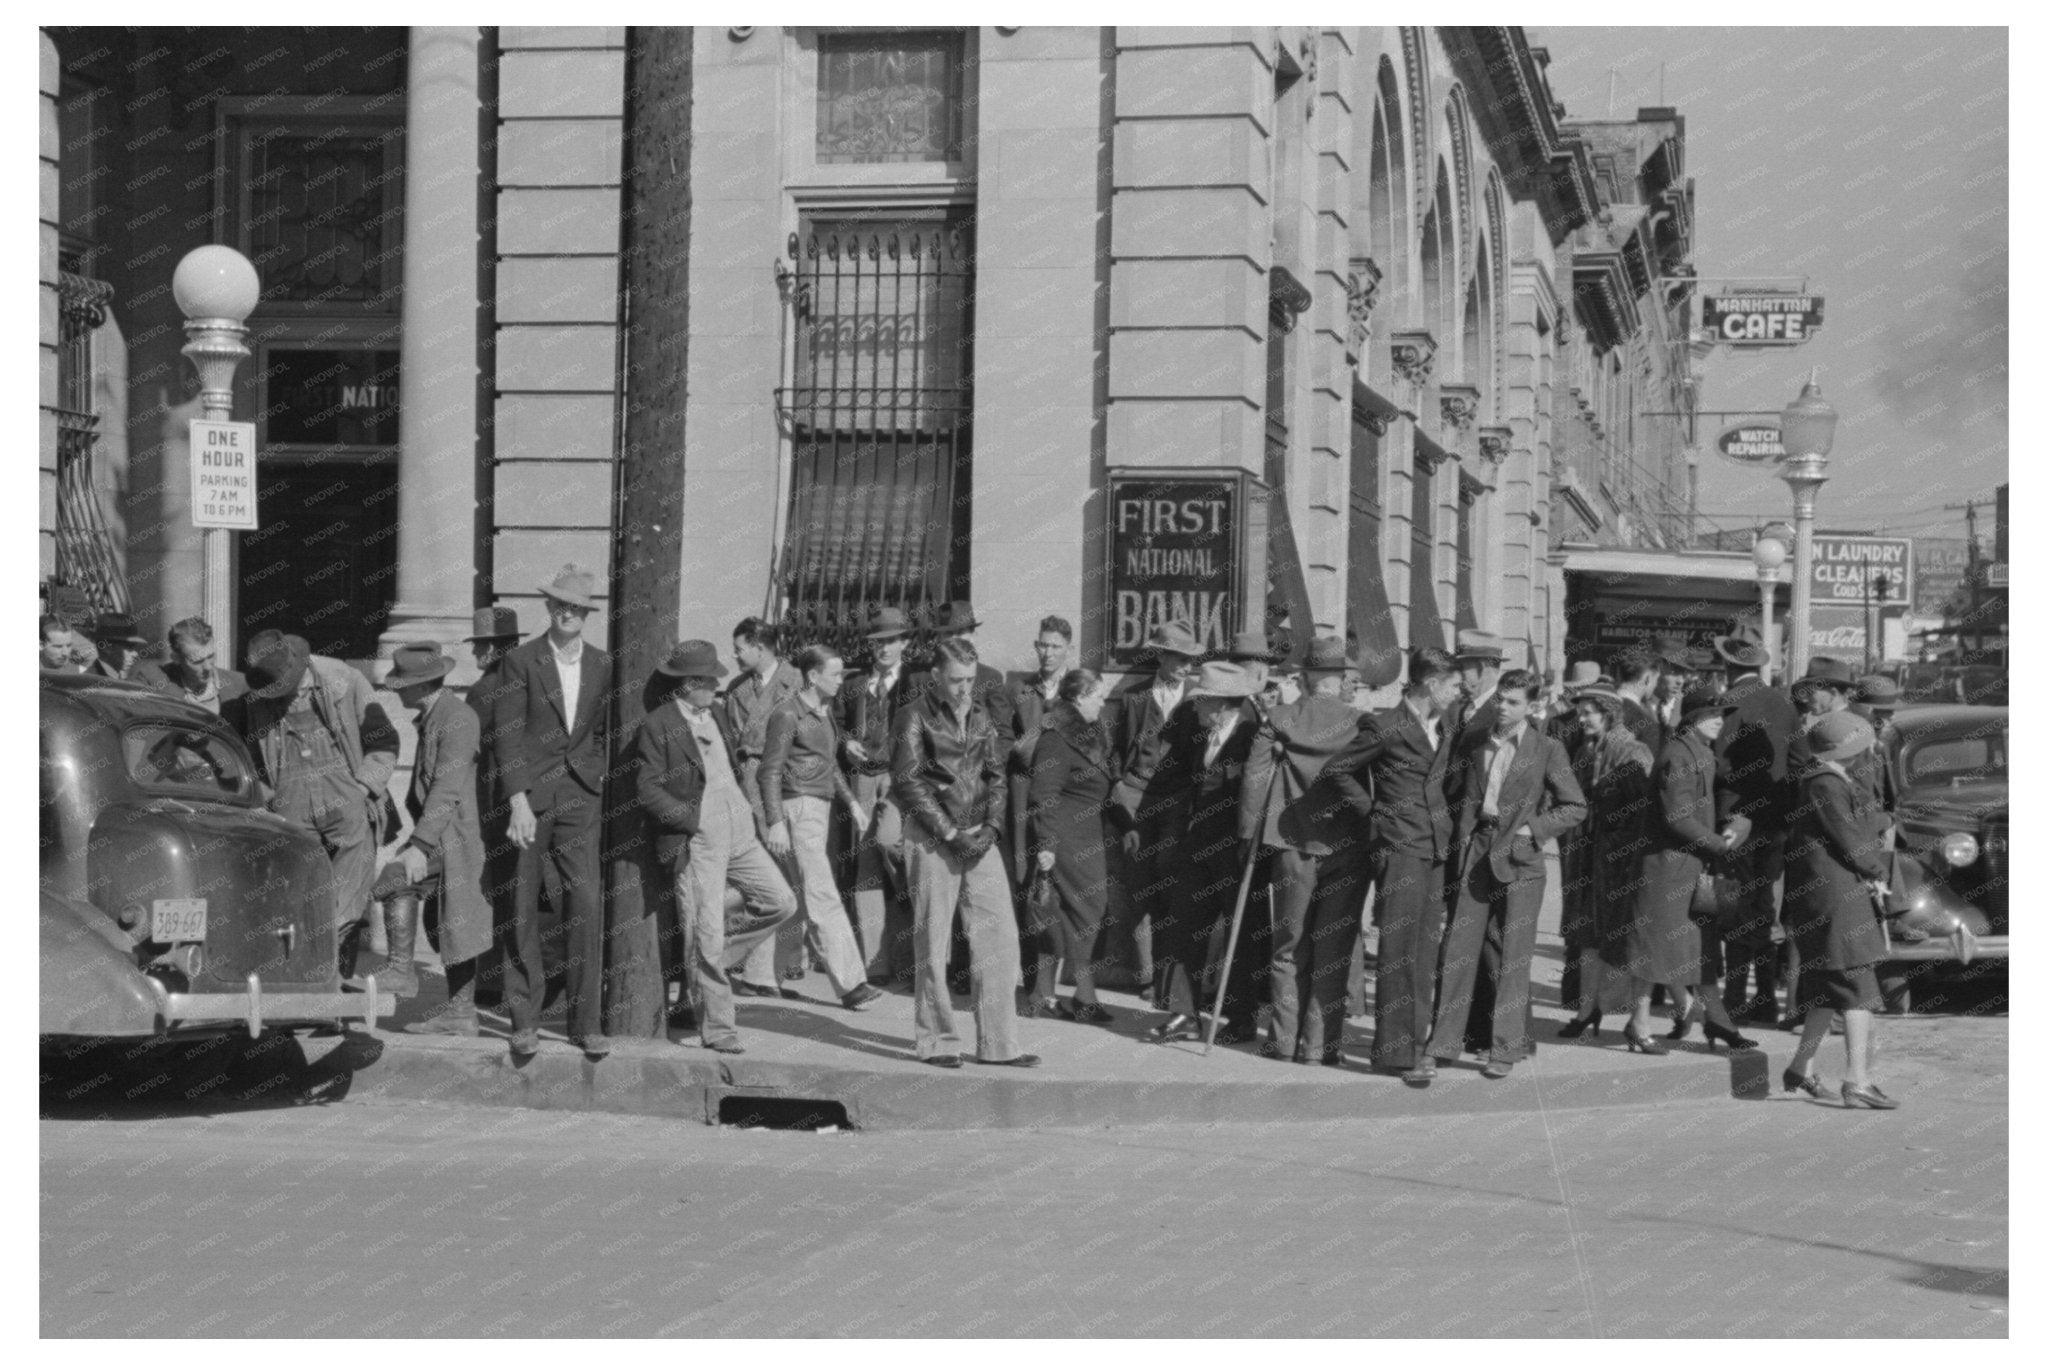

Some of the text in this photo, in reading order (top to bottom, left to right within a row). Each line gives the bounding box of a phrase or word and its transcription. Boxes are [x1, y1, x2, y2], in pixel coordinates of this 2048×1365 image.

[1716, 299, 1812, 312] MANHATTAN
[1723, 313, 1803, 338] CAFE
[208, 430, 239, 447] ONE
[1739, 429, 1779, 442] WATCH
[202, 450, 245, 468] HOUR
[200, 474, 248, 488] PARKING
[210, 489, 238, 502] 7 AM
[203, 504, 245, 516] TO 6 PM
[1118, 500, 1227, 533] FIRST
[1827, 544, 1904, 562] LAUNDRY
[1127, 549, 1216, 576] NATIONAL
[1115, 590, 1228, 650] BANK
[157, 911, 204, 934] 389-667
